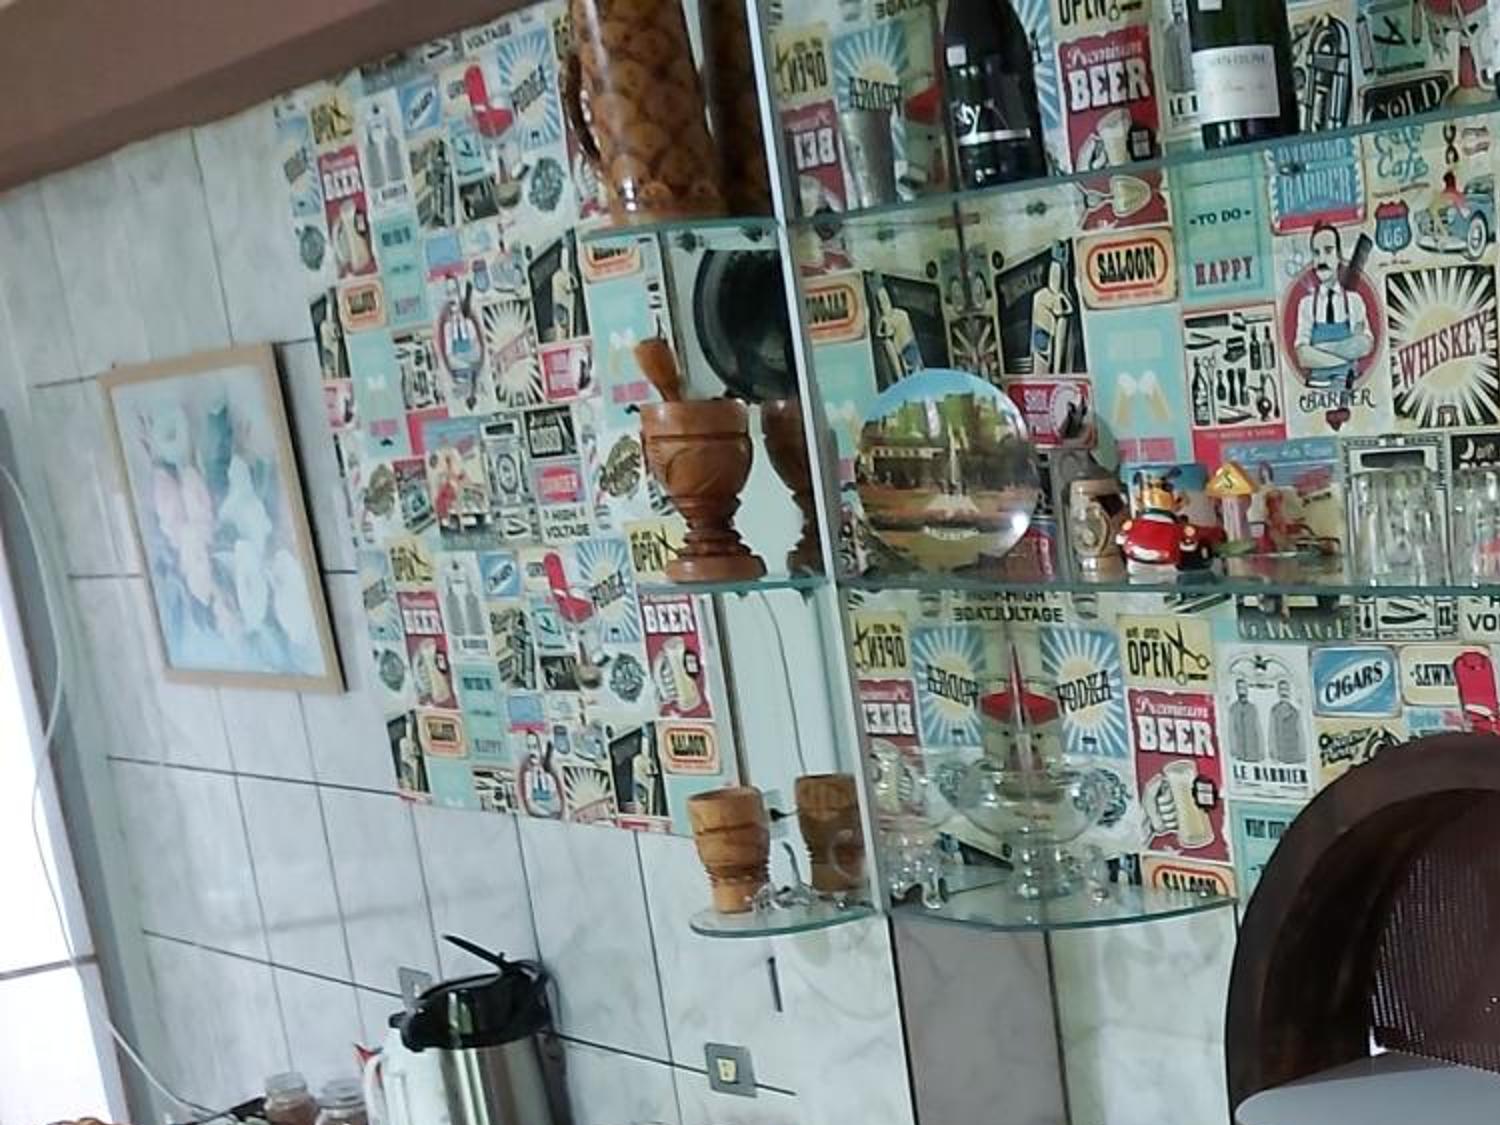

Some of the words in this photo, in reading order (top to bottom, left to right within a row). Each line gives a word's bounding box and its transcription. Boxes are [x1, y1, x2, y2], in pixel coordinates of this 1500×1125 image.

[1068, 57, 1150, 112] BEER
[1197, 212, 1218, 225] TO
[1221, 208, 1241, 222] DO
[1097, 247, 1156, 284] SALOON
[1195, 256, 1252, 287] HAPPY
[1400, 310, 1490, 389] WHISKEY
[643, 602, 696, 633] BEER
[1128, 640, 1174, 678] OPEN
[1056, 670, 1114, 714] VODKA
[1324, 660, 1384, 703] CIGARS
[1136, 714, 1216, 758] BEER
